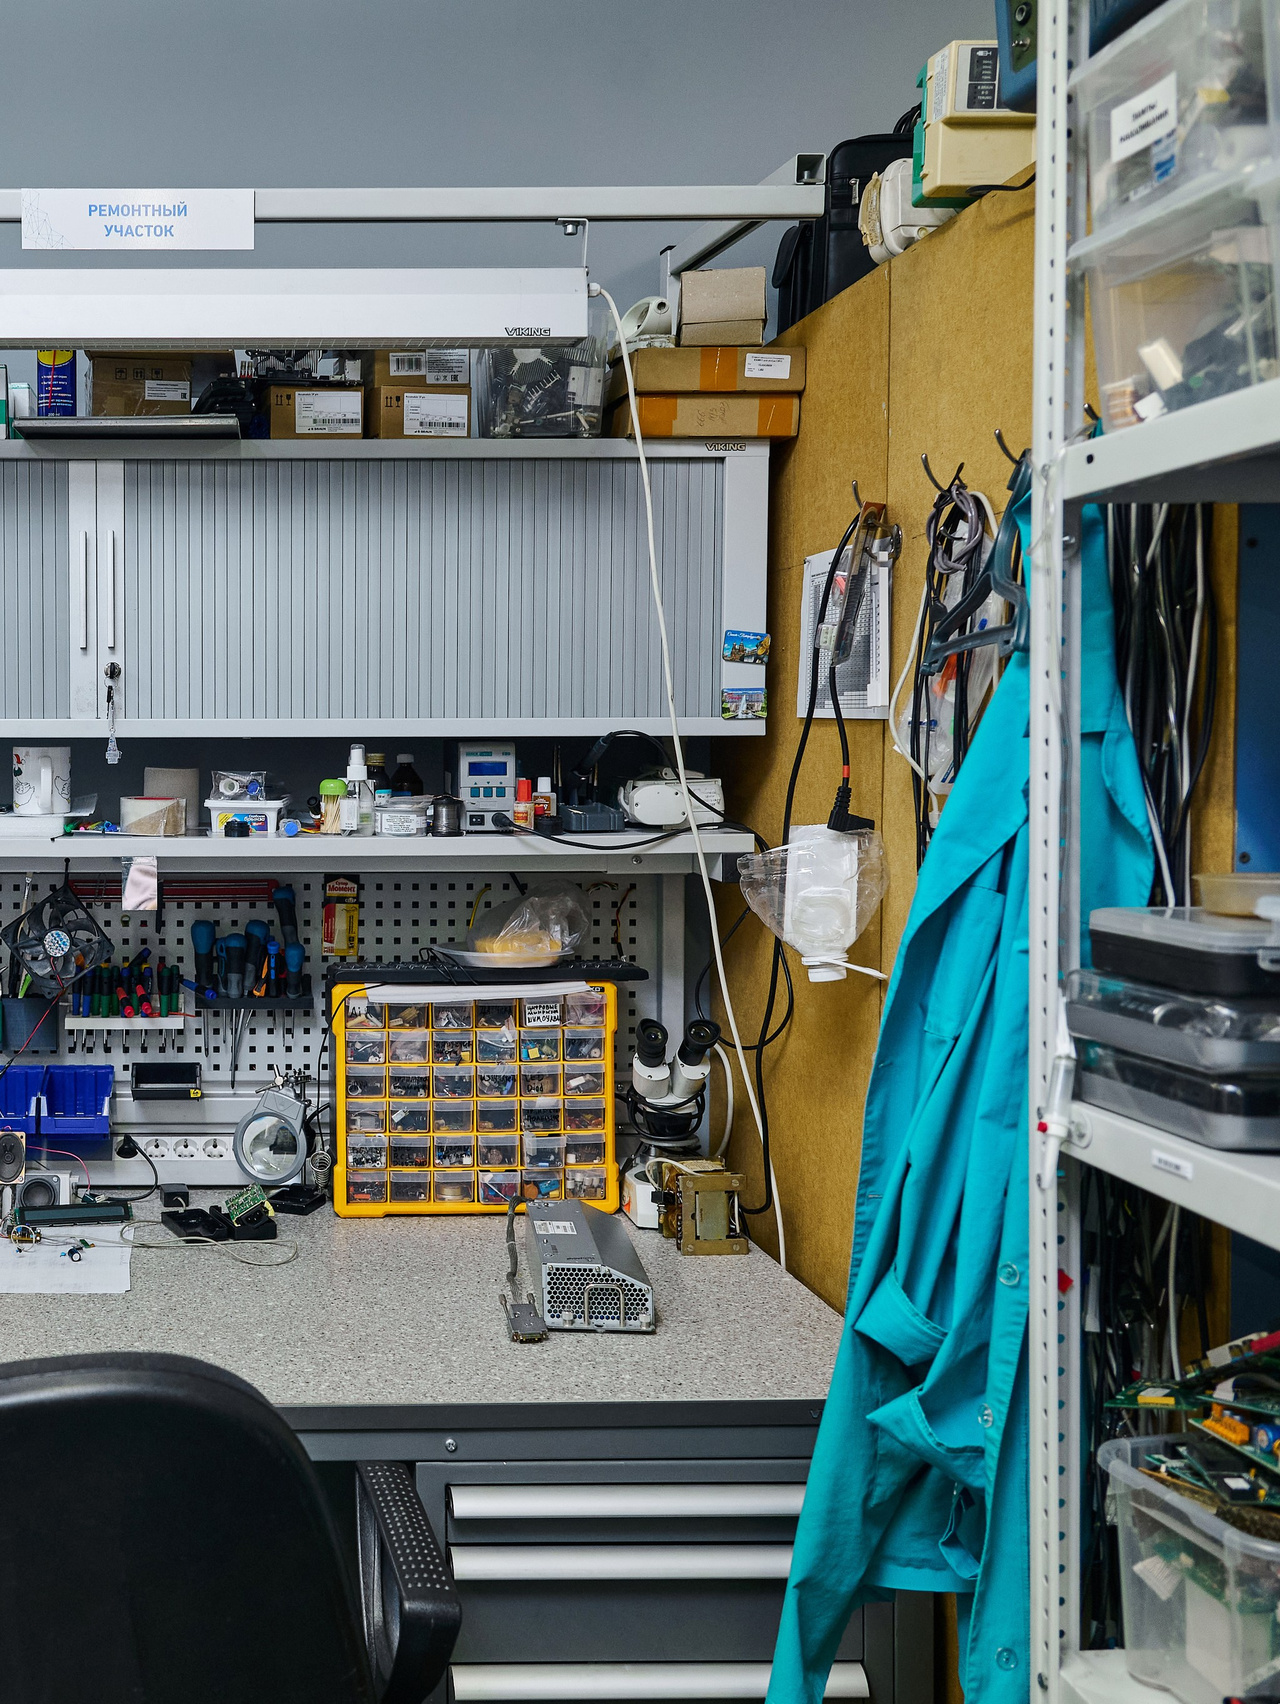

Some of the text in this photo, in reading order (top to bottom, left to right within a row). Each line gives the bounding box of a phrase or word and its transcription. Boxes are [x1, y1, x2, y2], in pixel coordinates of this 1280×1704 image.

[88, 201, 187, 216] РЕМОНТНЫЙ
[104, 225, 174, 237] УЧАСТОК
[505, 327, 551, 336] VIKING
[705, 443, 746, 451] VIKING
